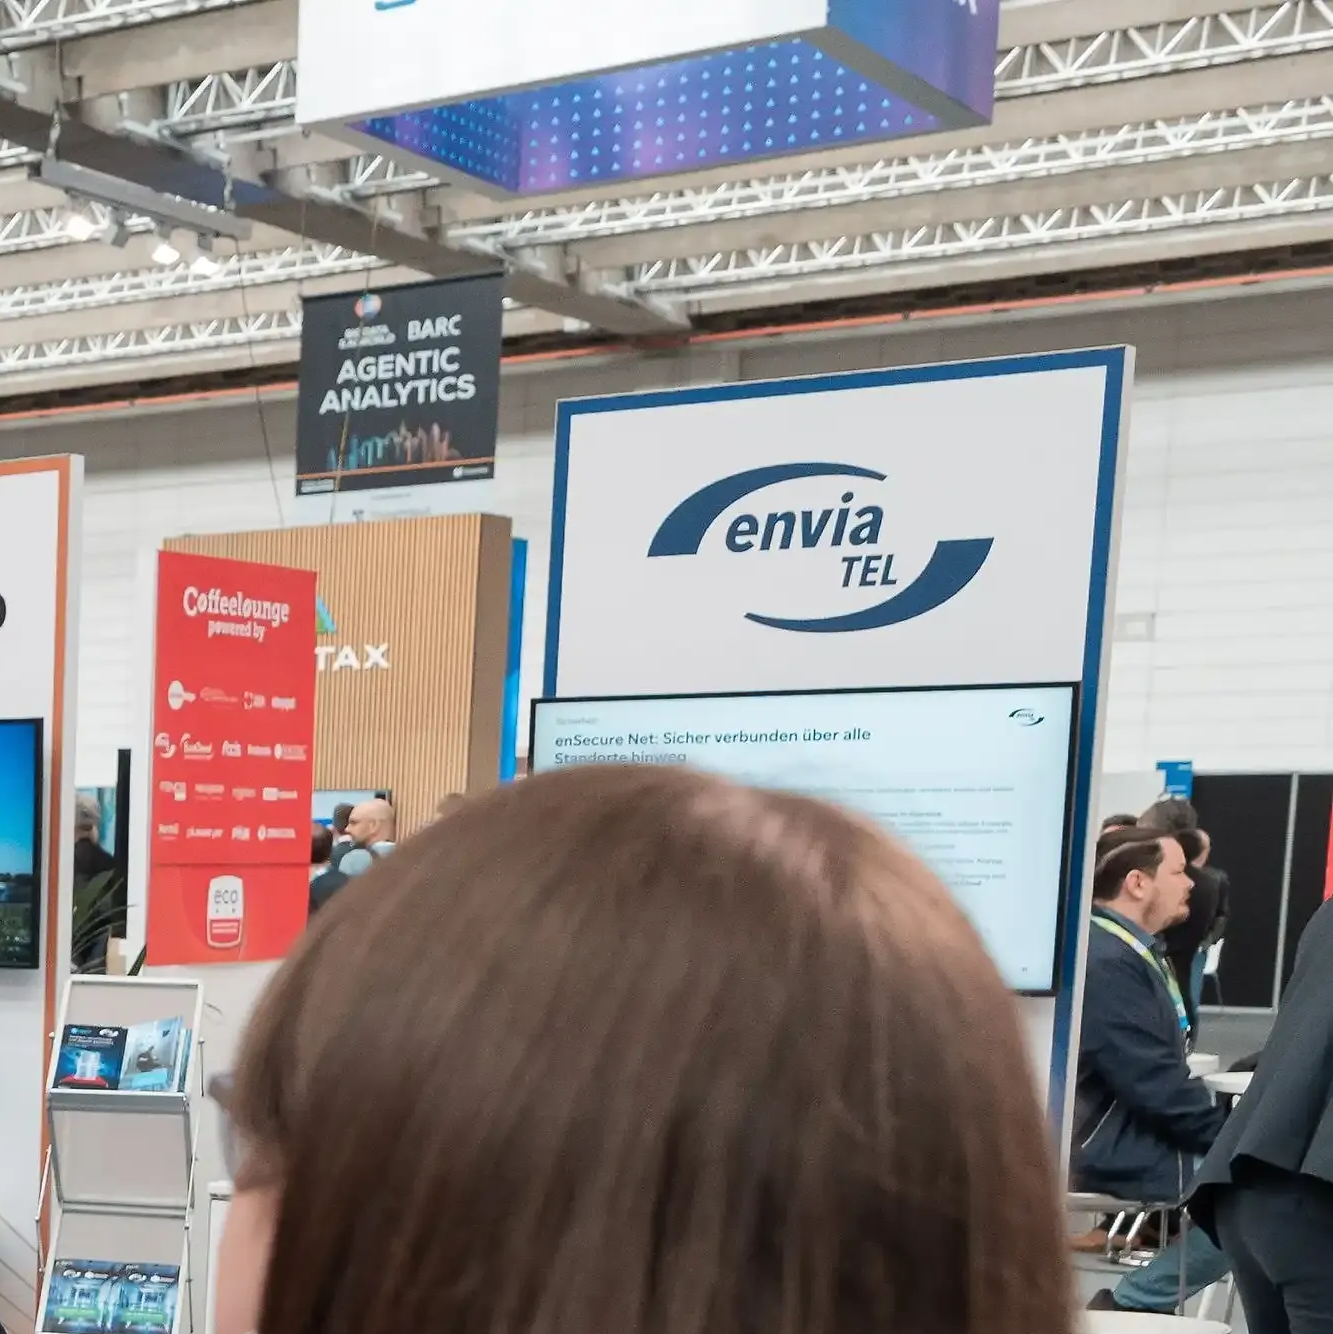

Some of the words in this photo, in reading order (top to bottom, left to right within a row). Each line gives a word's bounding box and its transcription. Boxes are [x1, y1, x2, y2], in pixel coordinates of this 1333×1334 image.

[407, 314, 463, 342] BARC
[336, 346, 461, 385] AGENTIC
[319, 373, 477, 415] ANALYTICS
[725, 491, 885, 553] envia
[841, 554, 898, 588] TEL
[183, 586, 290, 628] Coffeelounge
[207, 620, 251, 638] powered
[253, 624, 266, 642] by
[314, 643, 390, 671] TAX
[555, 734, 624, 748] enSecure
[628, 734, 658, 746] Net:
[663, 731, 710, 745] Sicher
[715, 729, 796, 744] verbunden
[802, 728, 839, 742] über
[843, 728, 871, 741] alle
